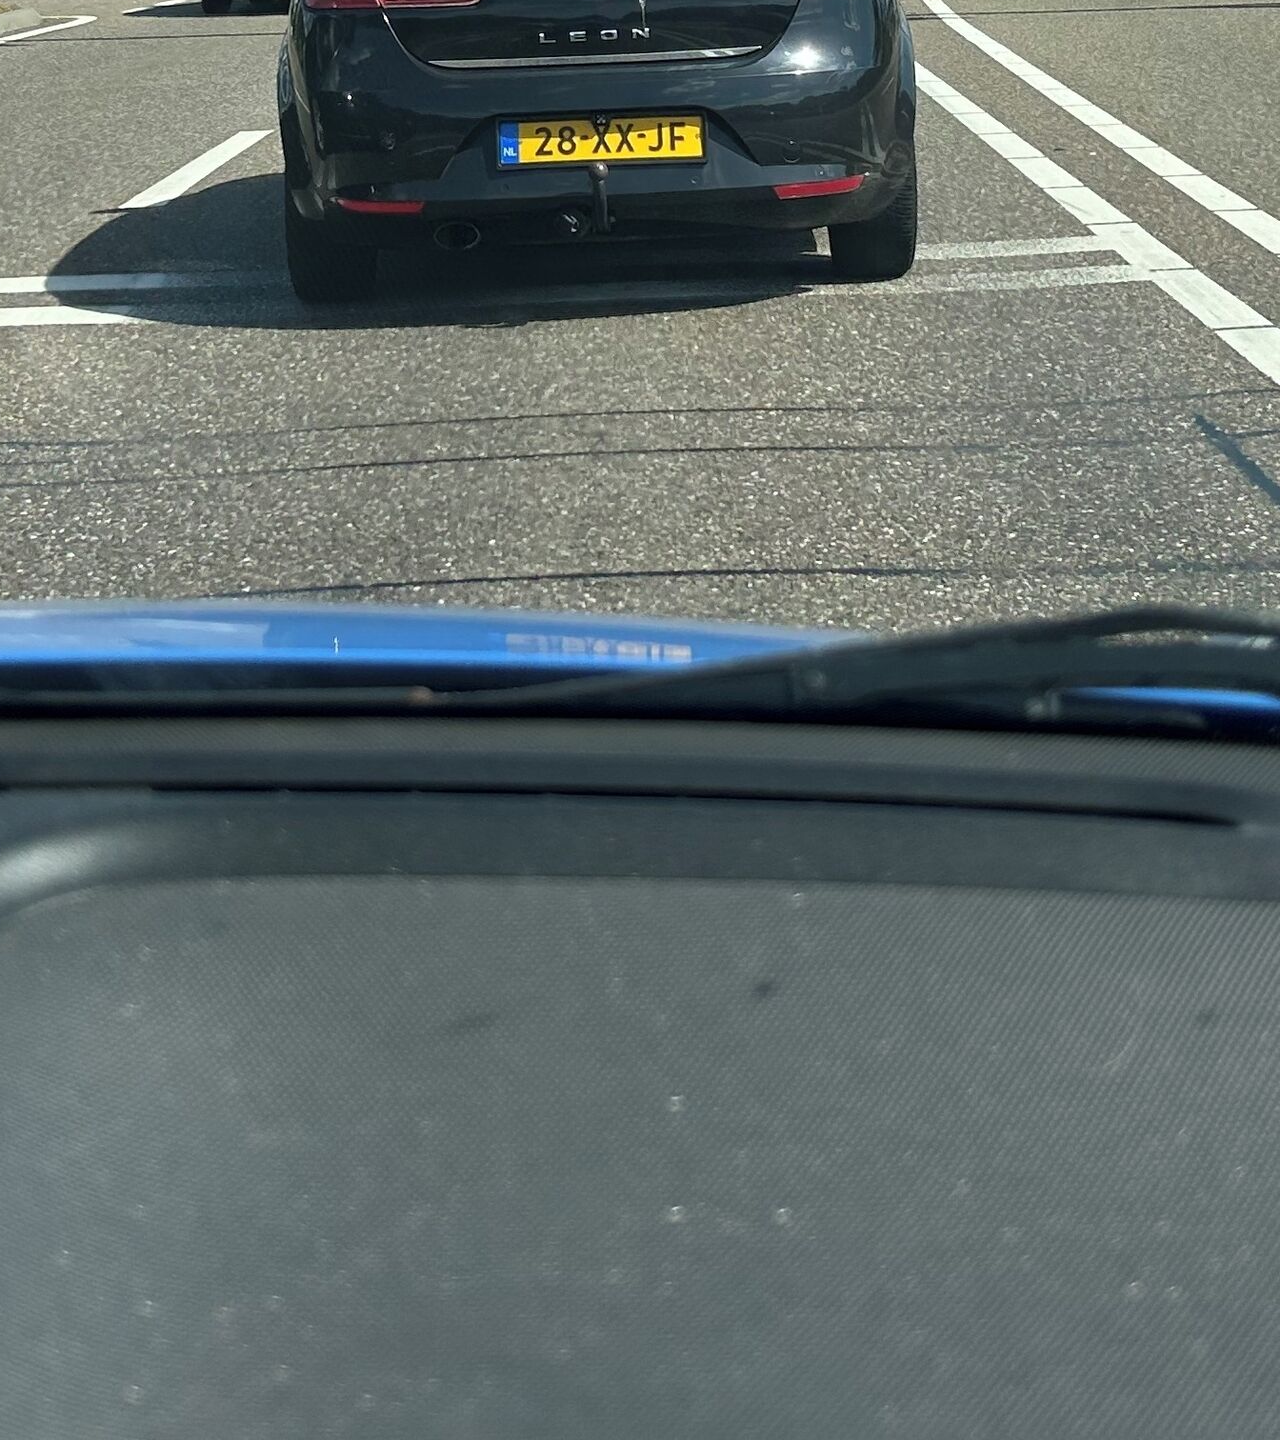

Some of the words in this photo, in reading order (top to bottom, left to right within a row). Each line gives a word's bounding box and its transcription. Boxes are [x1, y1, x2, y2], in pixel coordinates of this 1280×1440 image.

[538, 27, 650, 44] LEON
[534, 122, 686, 157] 28-XX-JF
[503, 146, 518, 157] NL
